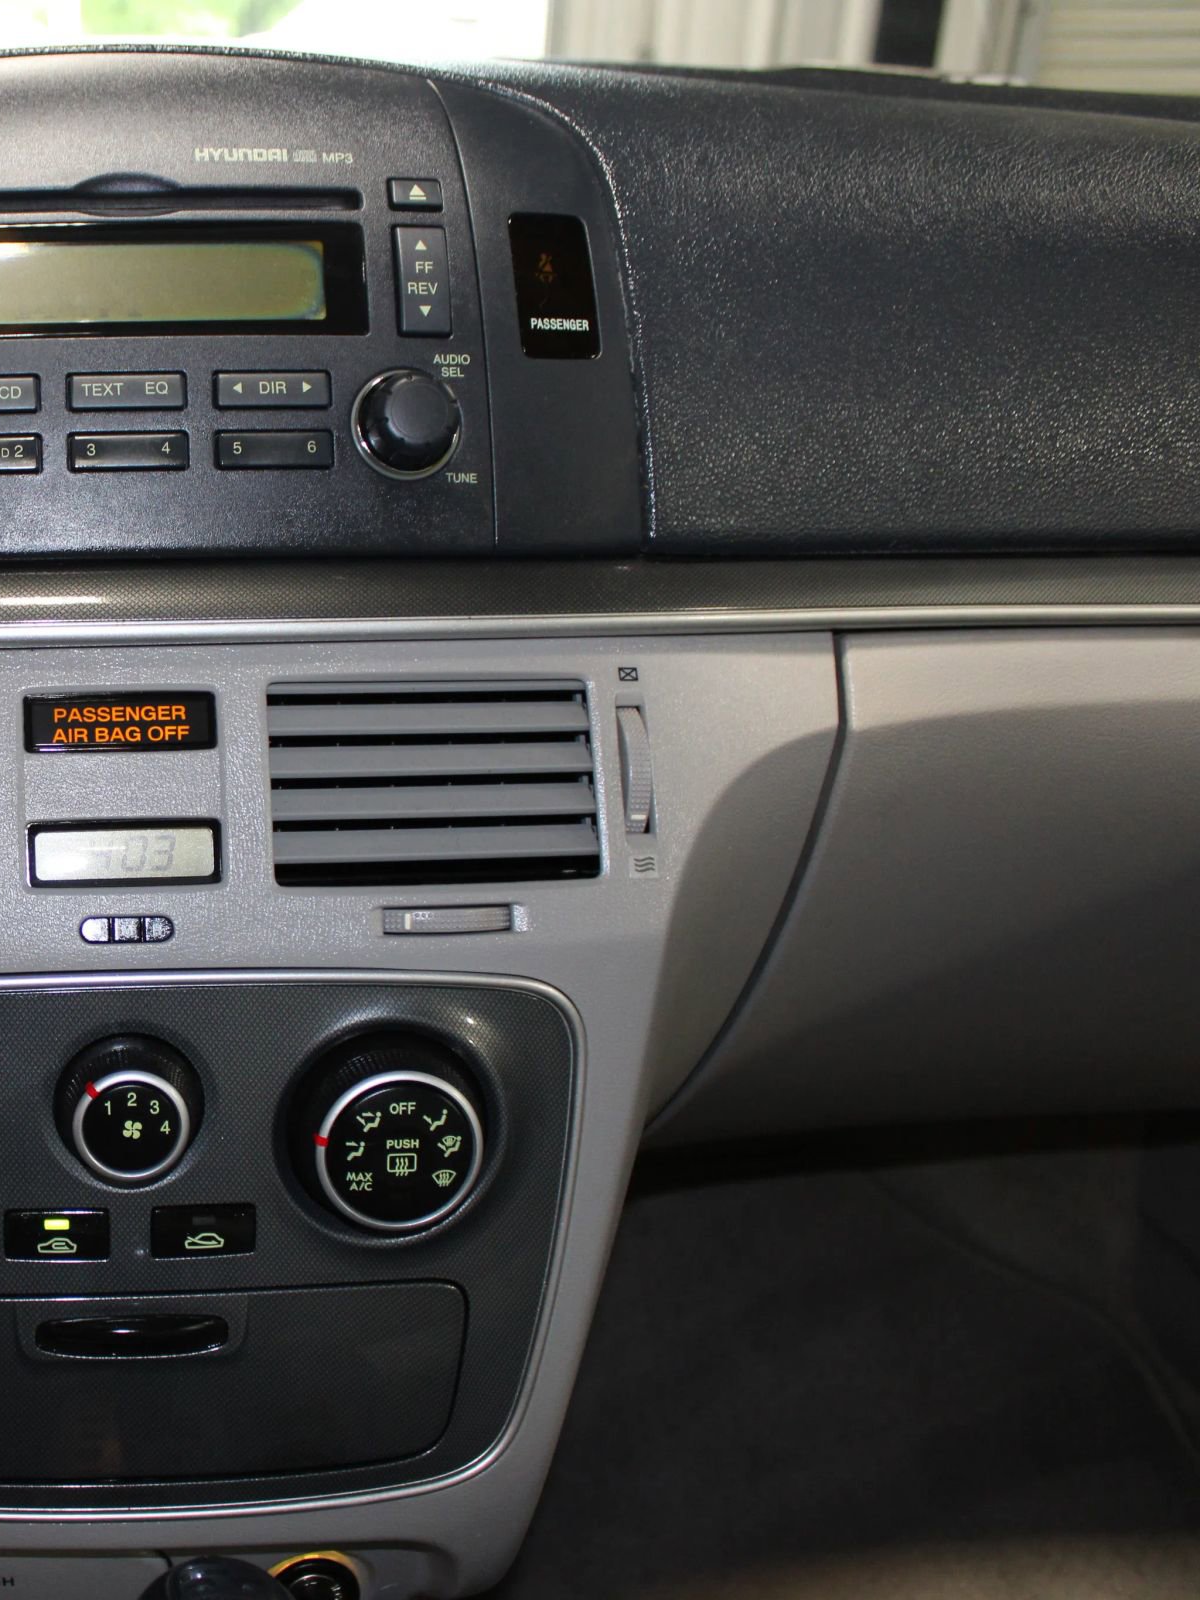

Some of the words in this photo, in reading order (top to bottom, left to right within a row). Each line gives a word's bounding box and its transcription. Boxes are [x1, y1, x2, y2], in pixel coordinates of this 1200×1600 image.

[195, 148, 288, 162] HYUNDAI
[322, 152, 353, 164] MP3
[415, 261, 433, 273] FF
[407, 282, 438, 295] REV
[530, 317, 590, 331] PASSENGER
[433, 354, 470, 366] AUDIO
[441, 366, 464, 378] SEL
[0, 386, 22, 400] CD
[82, 382, 124, 397] TEXT
[145, 381, 168, 395] EQ
[259, 381, 287, 394] DIR
[14, 445, 24, 458] 2
[86, 443, 96, 456] 3
[161, 441, 170, 454] 4
[233, 441, 242, 454] 5
[307, 440, 317, 453] 6
[446, 473, 478, 484] TUNE
[53, 704, 187, 723] PASSENGER
[52, 727, 88, 743] AIR
[95, 726, 142, 742] BAG
[147, 725, 191, 741] OFF
[127, 1092, 137, 1107] 2
[104, 1100, 112, 1116] 1
[149, 1100, 160, 1115] 3
[389, 1102, 416, 1115] OFF
[160, 1120, 171, 1135] 4
[386, 1139, 420, 1150] PUSH
[346, 1172, 373, 1182] MAX
[350, 1182, 373, 1192] A/C
